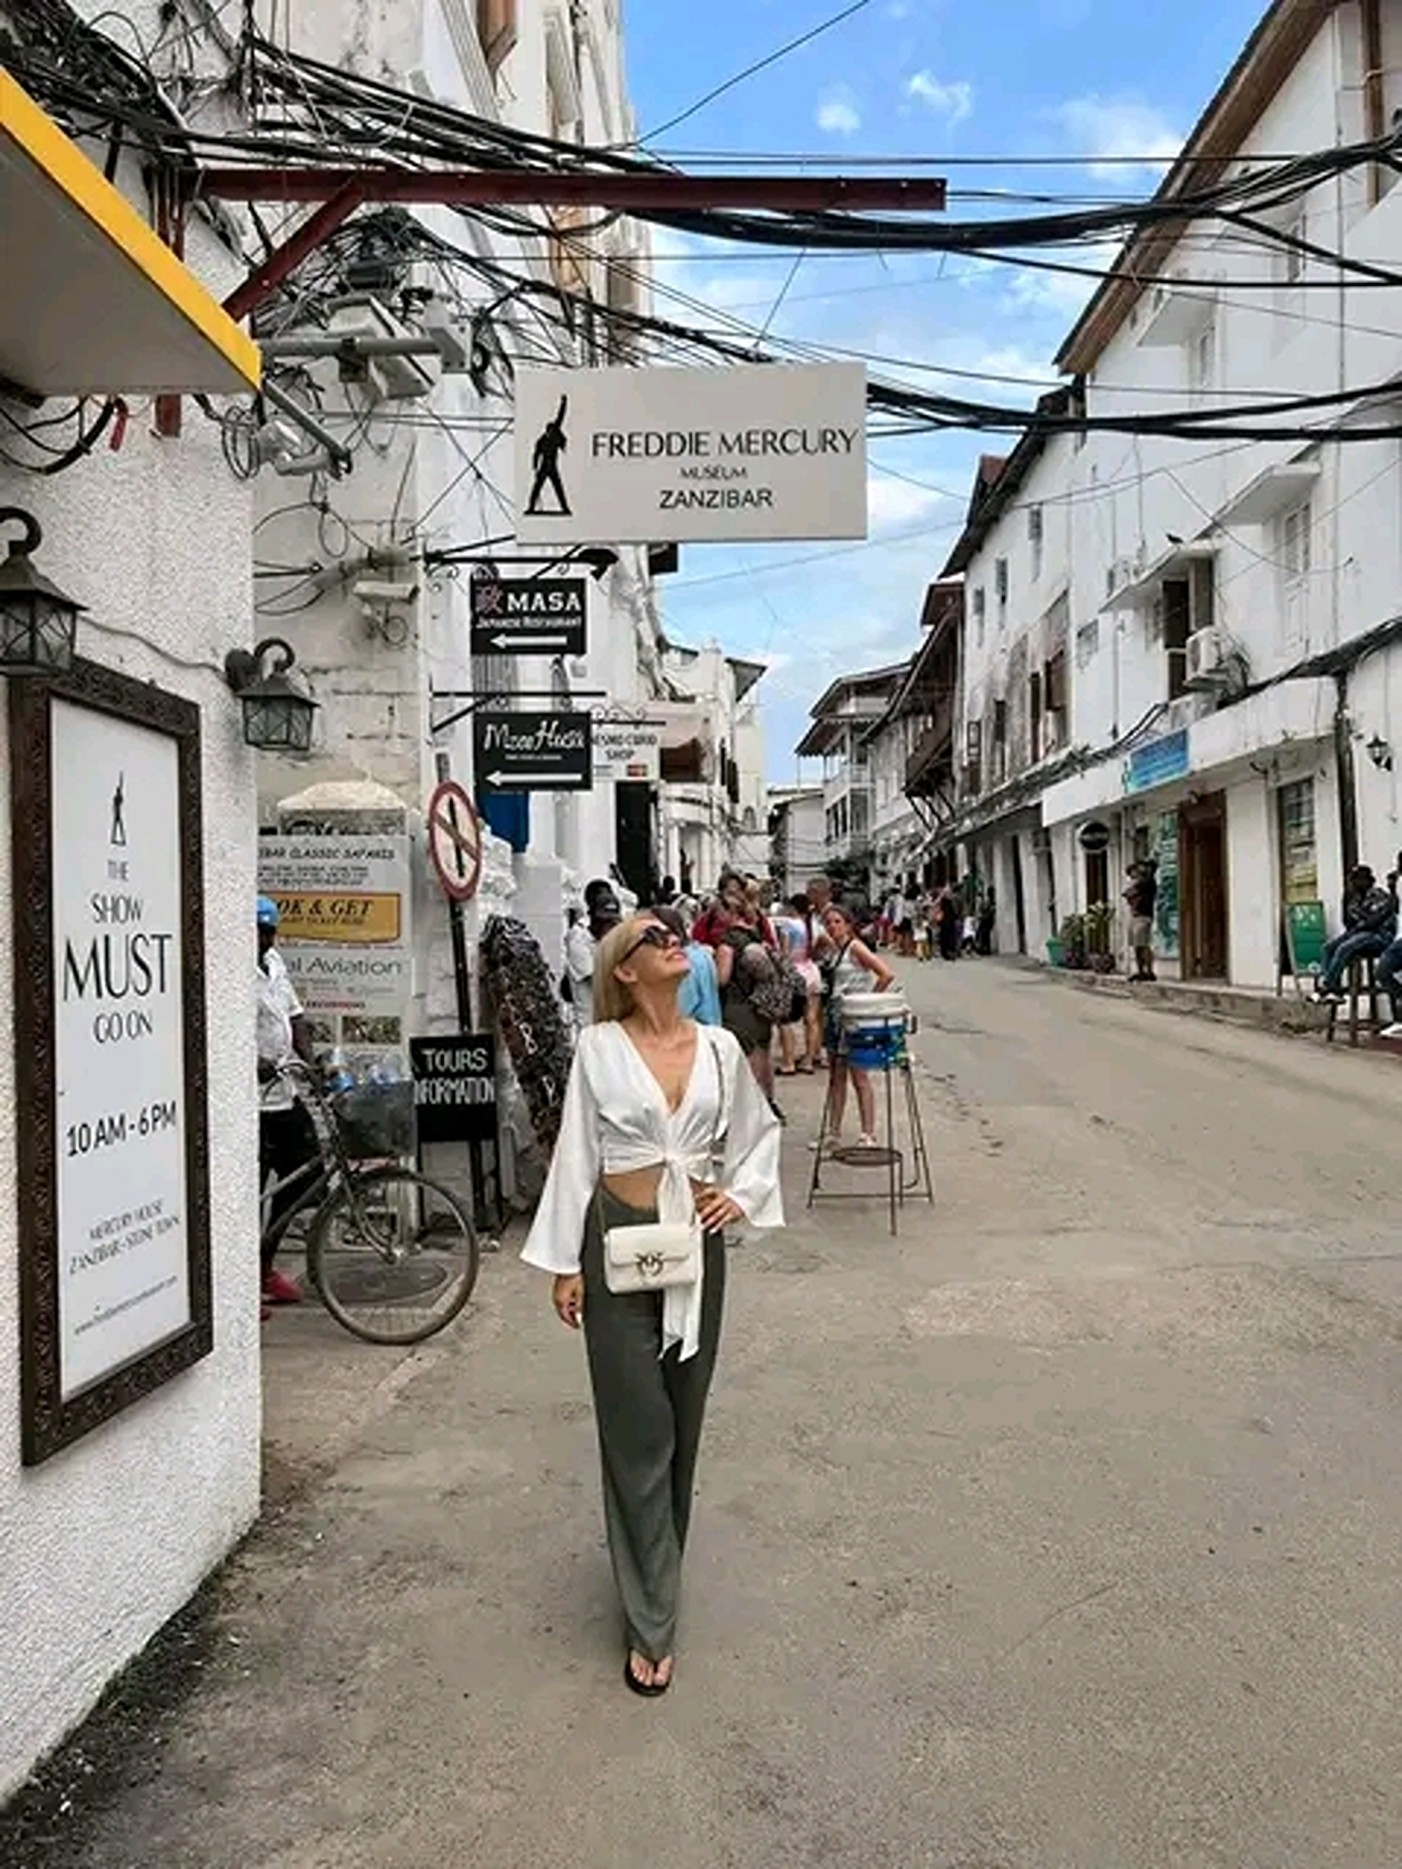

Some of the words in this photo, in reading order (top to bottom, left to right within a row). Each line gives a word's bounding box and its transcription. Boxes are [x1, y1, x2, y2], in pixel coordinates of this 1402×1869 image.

[592, 431, 711, 457] FREDDIE
[719, 428, 858, 455] MERCURY
[681, 465, 748, 480] MUSEUM
[660, 487, 773, 509] ZANZIBAR
[507, 592, 582, 611] MASA
[606, 749, 634, 760] SHOP
[107, 859, 129, 882] THE
[91, 893, 143, 924] SHOW
[309, 899, 323, 915] &
[330, 899, 374, 915] GET
[64, 932, 172, 1001] MUST
[306, 957, 403, 977] Aviation
[94, 1012, 123, 1043] GO
[126, 1009, 153, 1041] ON
[421, 1047, 488, 1073] TOURS
[67, 1122, 91, 1158] 10
[94, 1113, 126, 1149] AM
[139, 1107, 149, 1136] 6
[151, 1100, 177, 1133] PM
